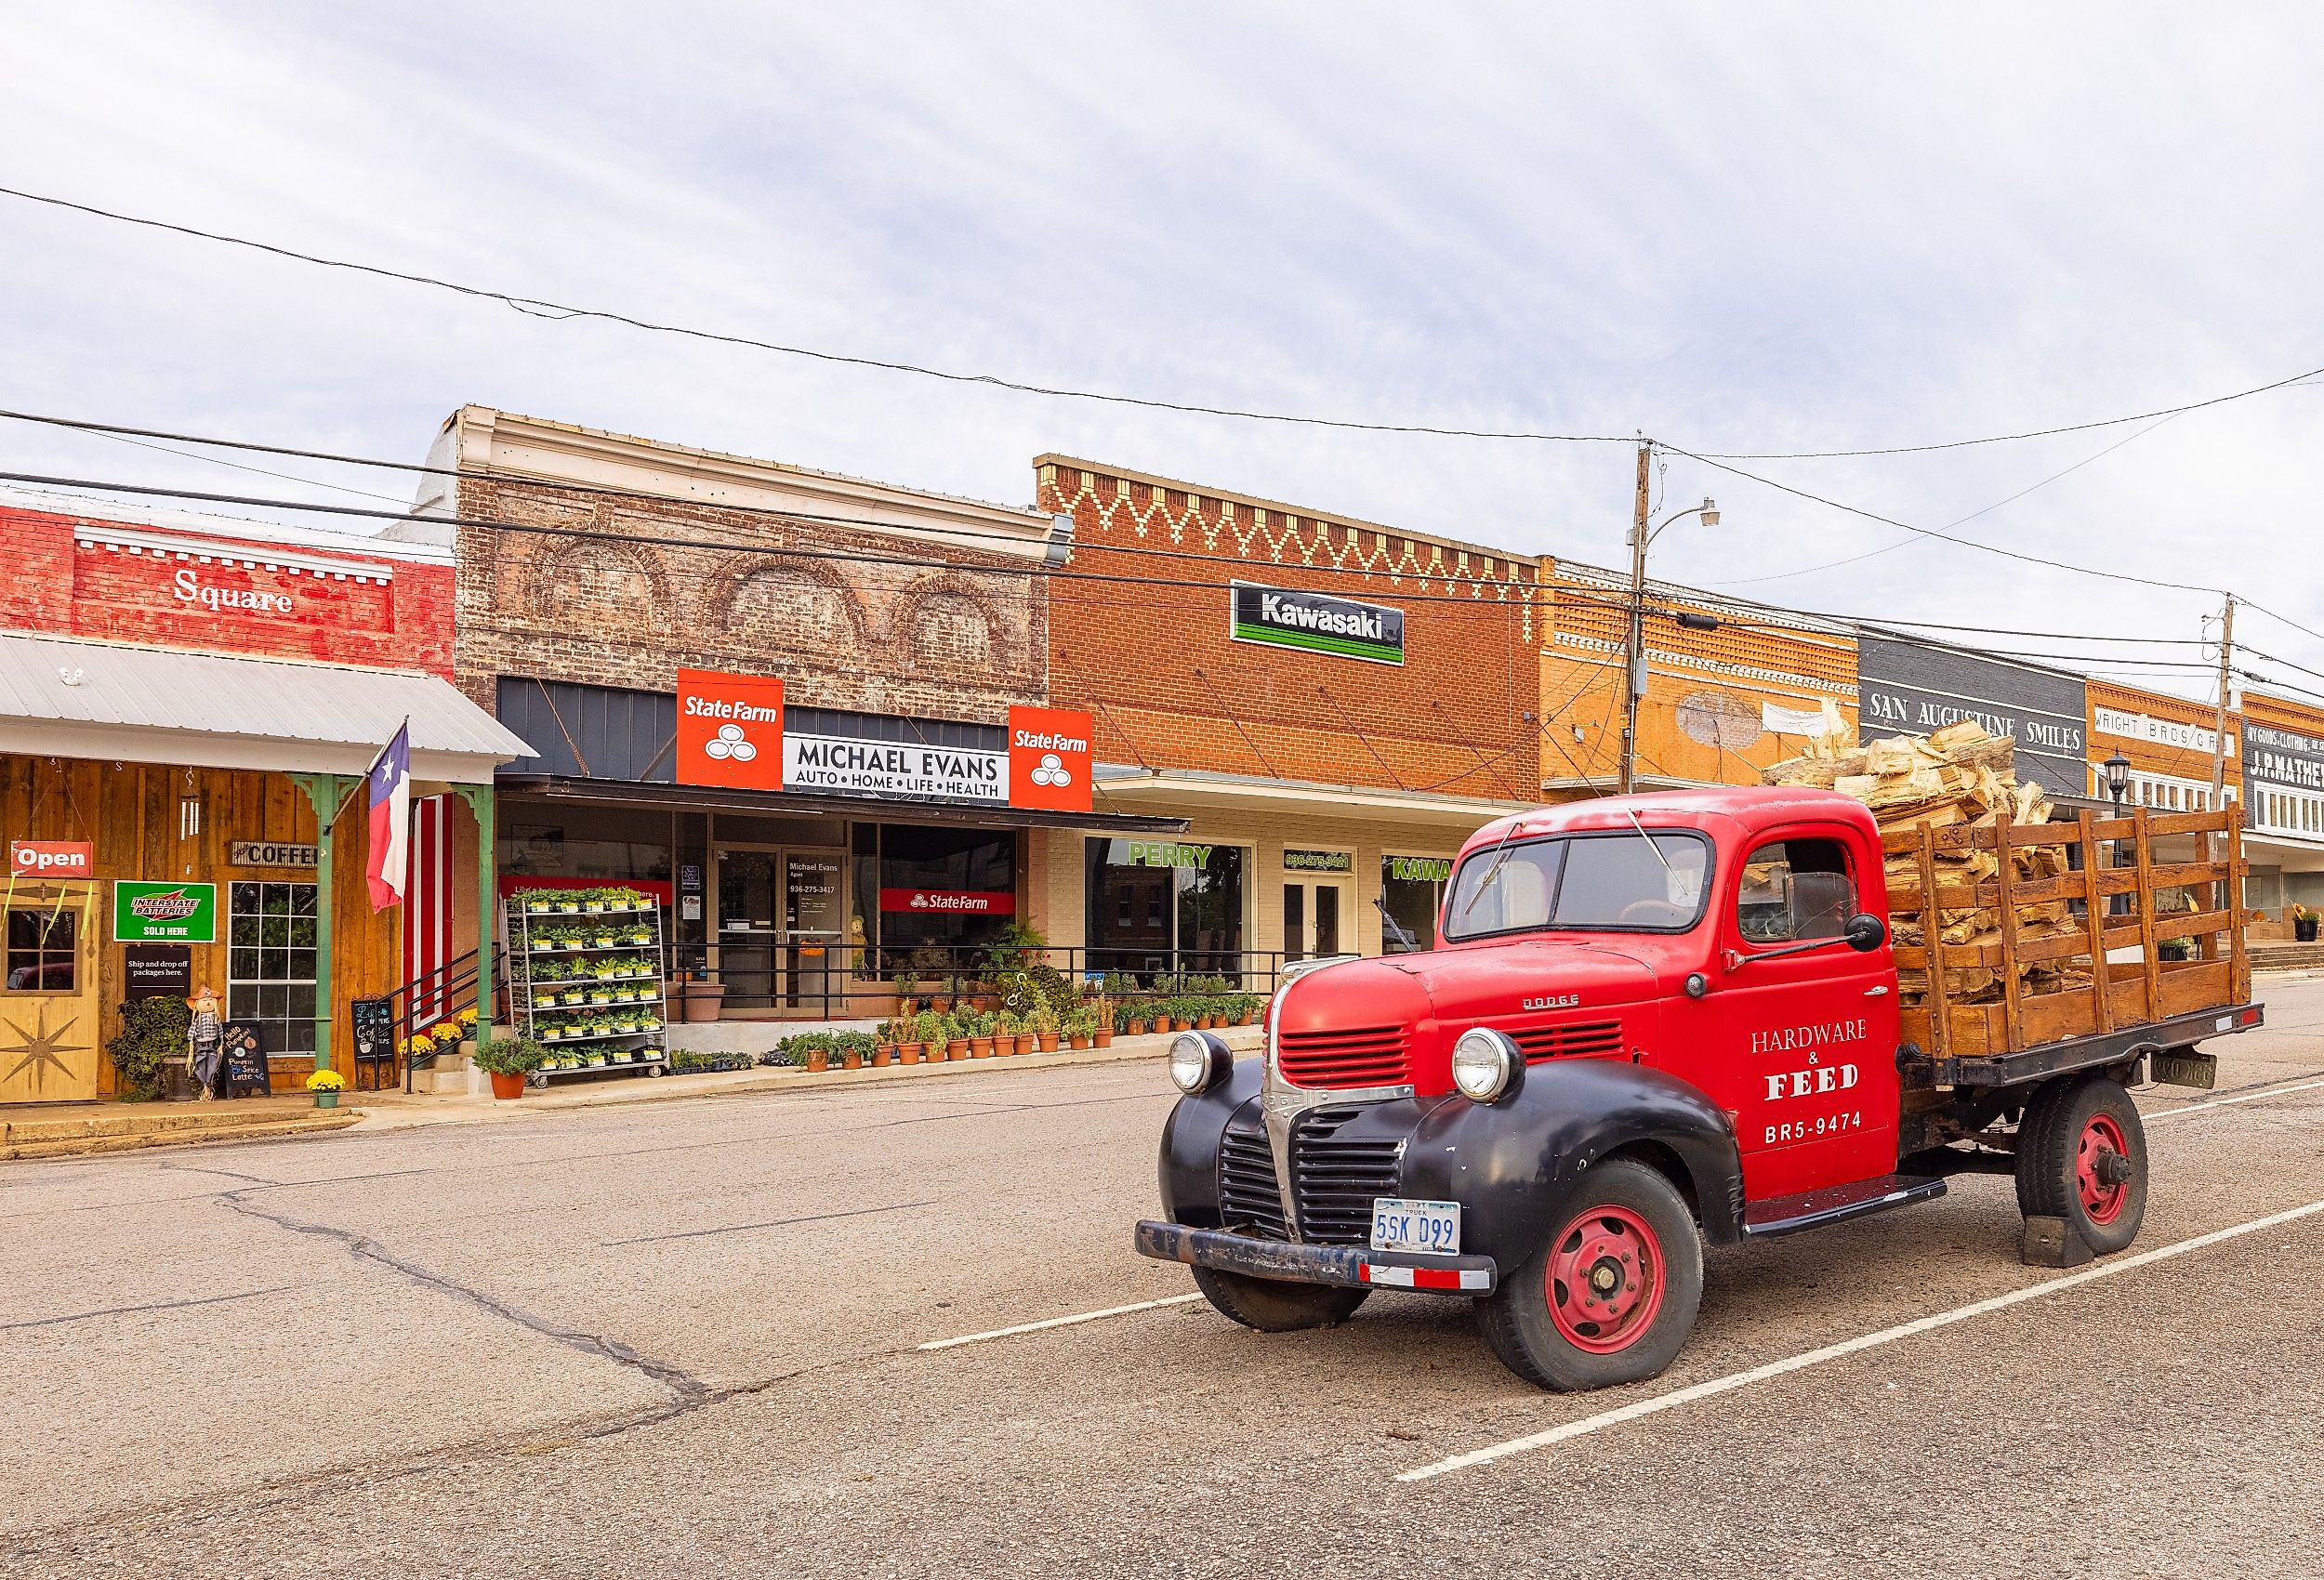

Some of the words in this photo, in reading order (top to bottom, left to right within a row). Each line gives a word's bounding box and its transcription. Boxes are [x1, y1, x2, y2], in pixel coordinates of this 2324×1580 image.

[174, 569, 293, 612] Square
[1261, 593, 1382, 639] Kawasaki
[1870, 693, 1908, 722] SAN
[2026, 721, 2080, 751] SMILES
[2149, 723, 2187, 744] BROS
[798, 741, 912, 774] MICHAEL
[922, 753, 997, 782] EVANS
[796, 770, 838, 785] AUTO
[852, 773, 892, 789] HOME
[906, 778, 933, 792] LIFE
[946, 781, 998, 797] HEALTH
[18, 849, 85, 870] Open
[1129, 842, 1212, 870] PERRY
[1286, 855, 1349, 868] 936-275-3421
[789, 862, 817, 871] Michael
[818, 862, 838, 872] Evans
[789, 885, 835, 893] 936-275-3417
[133, 899, 198, 907] INTERSTATE
[143, 927, 165, 936] SOLD
[167, 927, 189, 936] HERE
[128, 960, 145, 968] Ship
[160, 960, 178, 968] drop
[1523, 994, 1579, 1009] DODGE
[224, 1026, 242, 1041] Hello
[1750, 1019, 1867, 1054] HARDWARE
[1808, 1051, 1818, 1064] &
[242, 1065, 259, 1073] Spice
[1763, 1063, 1858, 1101] FEED
[1764, 1111, 1861, 1144] BR5-9474
[1377, 1215, 1410, 1242] 5SK
[1419, 1217, 1453, 1244] D99
